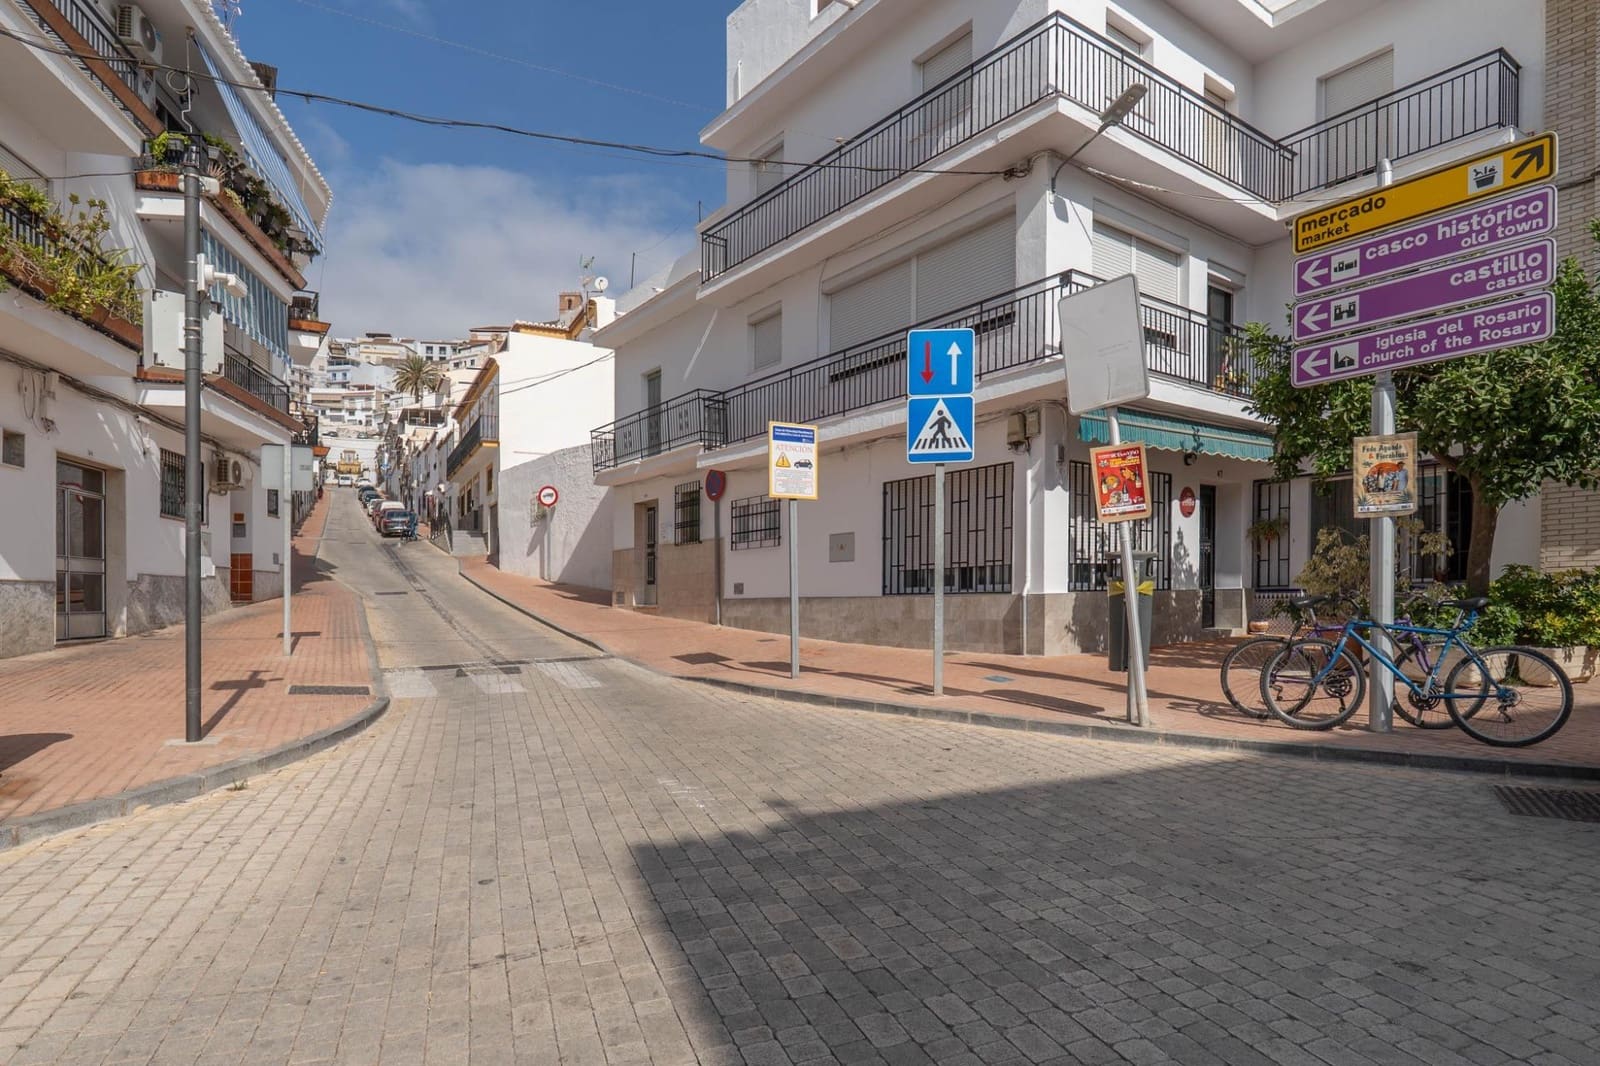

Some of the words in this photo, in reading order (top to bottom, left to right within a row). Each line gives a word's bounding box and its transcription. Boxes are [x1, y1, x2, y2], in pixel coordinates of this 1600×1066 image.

[1301, 196, 1386, 233] mercado
[1365, 233, 1428, 260] casco
[1437, 199, 1544, 241] histórico
[1301, 223, 1350, 246] market
[1460, 231, 1489, 248] old
[1496, 217, 1544, 238] town
[1449, 252, 1543, 286] castillo
[1485, 269, 1543, 292] castle
[1362, 346, 1414, 366] church
[1420, 339, 1437, 354] of
[1444, 333, 1473, 349] the
[1479, 319, 1542, 343] Rosary
[1376, 328, 1427, 349] iglesia
[1436, 319, 1463, 336] del
[1473, 305, 1542, 328] Rosario
